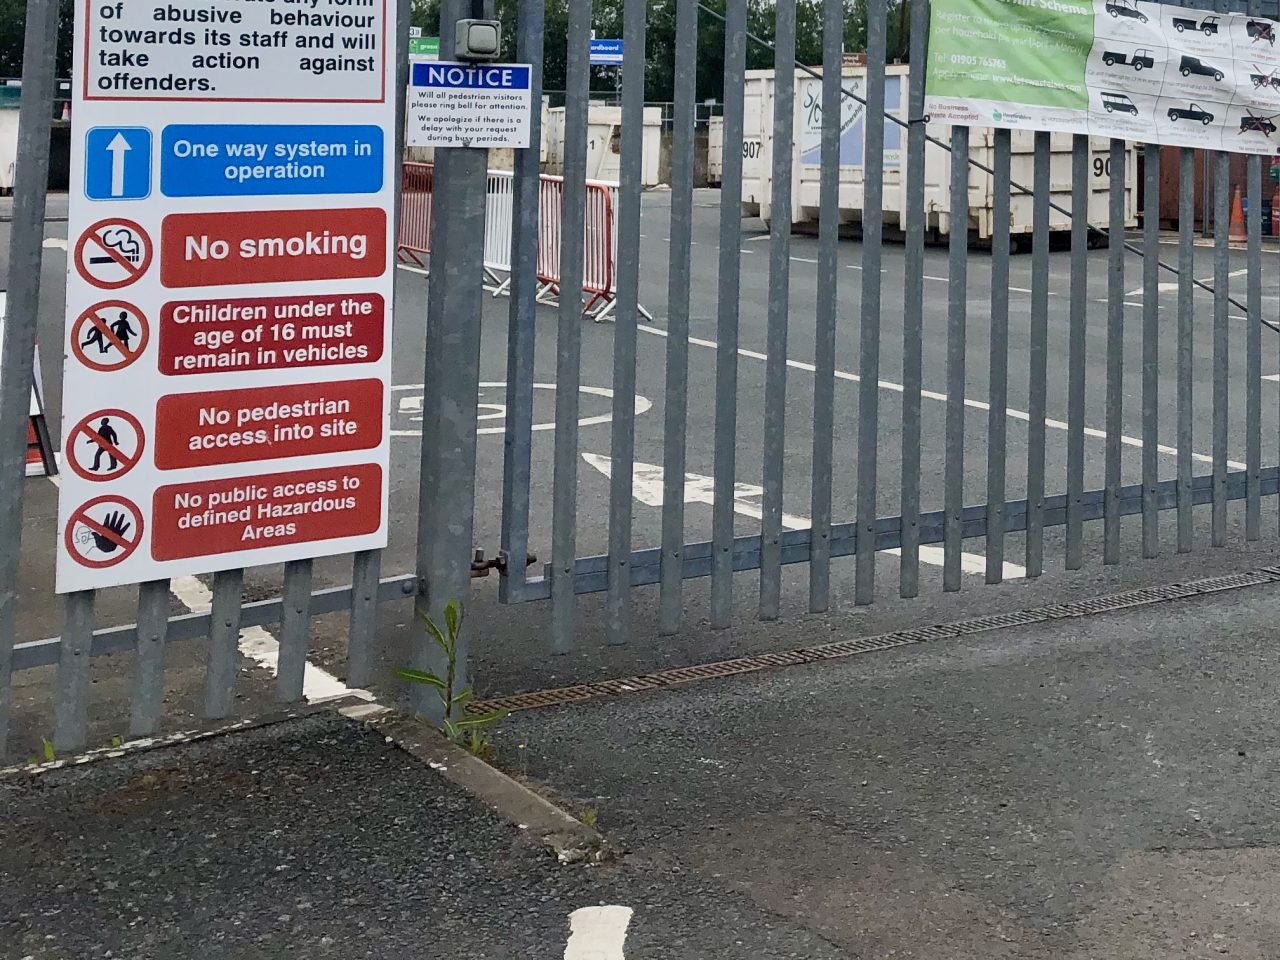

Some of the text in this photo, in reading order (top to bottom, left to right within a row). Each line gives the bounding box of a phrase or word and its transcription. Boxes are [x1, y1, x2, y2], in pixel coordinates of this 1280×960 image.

[100, 2, 375, 28] of abusive behaviour
[100, 25, 376, 50] towards its staff and will
[590, 43, 619, 52] ardboard
[99, 49, 375, 74] take action against
[98, 74, 216, 91] offenders.
[428, 67, 512, 86] NOTICE
[440, 102, 455, 110] ring
[458, 101, 472, 109] bell
[434, 115, 472, 124] apologize
[948, 112, 979, 121] Accepted
[421, 124, 443, 132] delay
[427, 134, 452, 142] during
[173, 140, 371, 161] One way system in
[743, 141, 761, 159] 907
[224, 162, 325, 183] operation
[185, 230, 367, 260] No smoking
[173, 299, 372, 324] Children under the
[194, 321, 353, 349] age of 16 must
[174, 343, 368, 369] remain in vehicles
[199, 398, 350, 426] No pedestrian
[189, 419, 357, 450] access into site
[175, 475, 360, 510] No public access to
[178, 496, 356, 529] defined Hazardous
[241, 522, 296, 541] Areas
